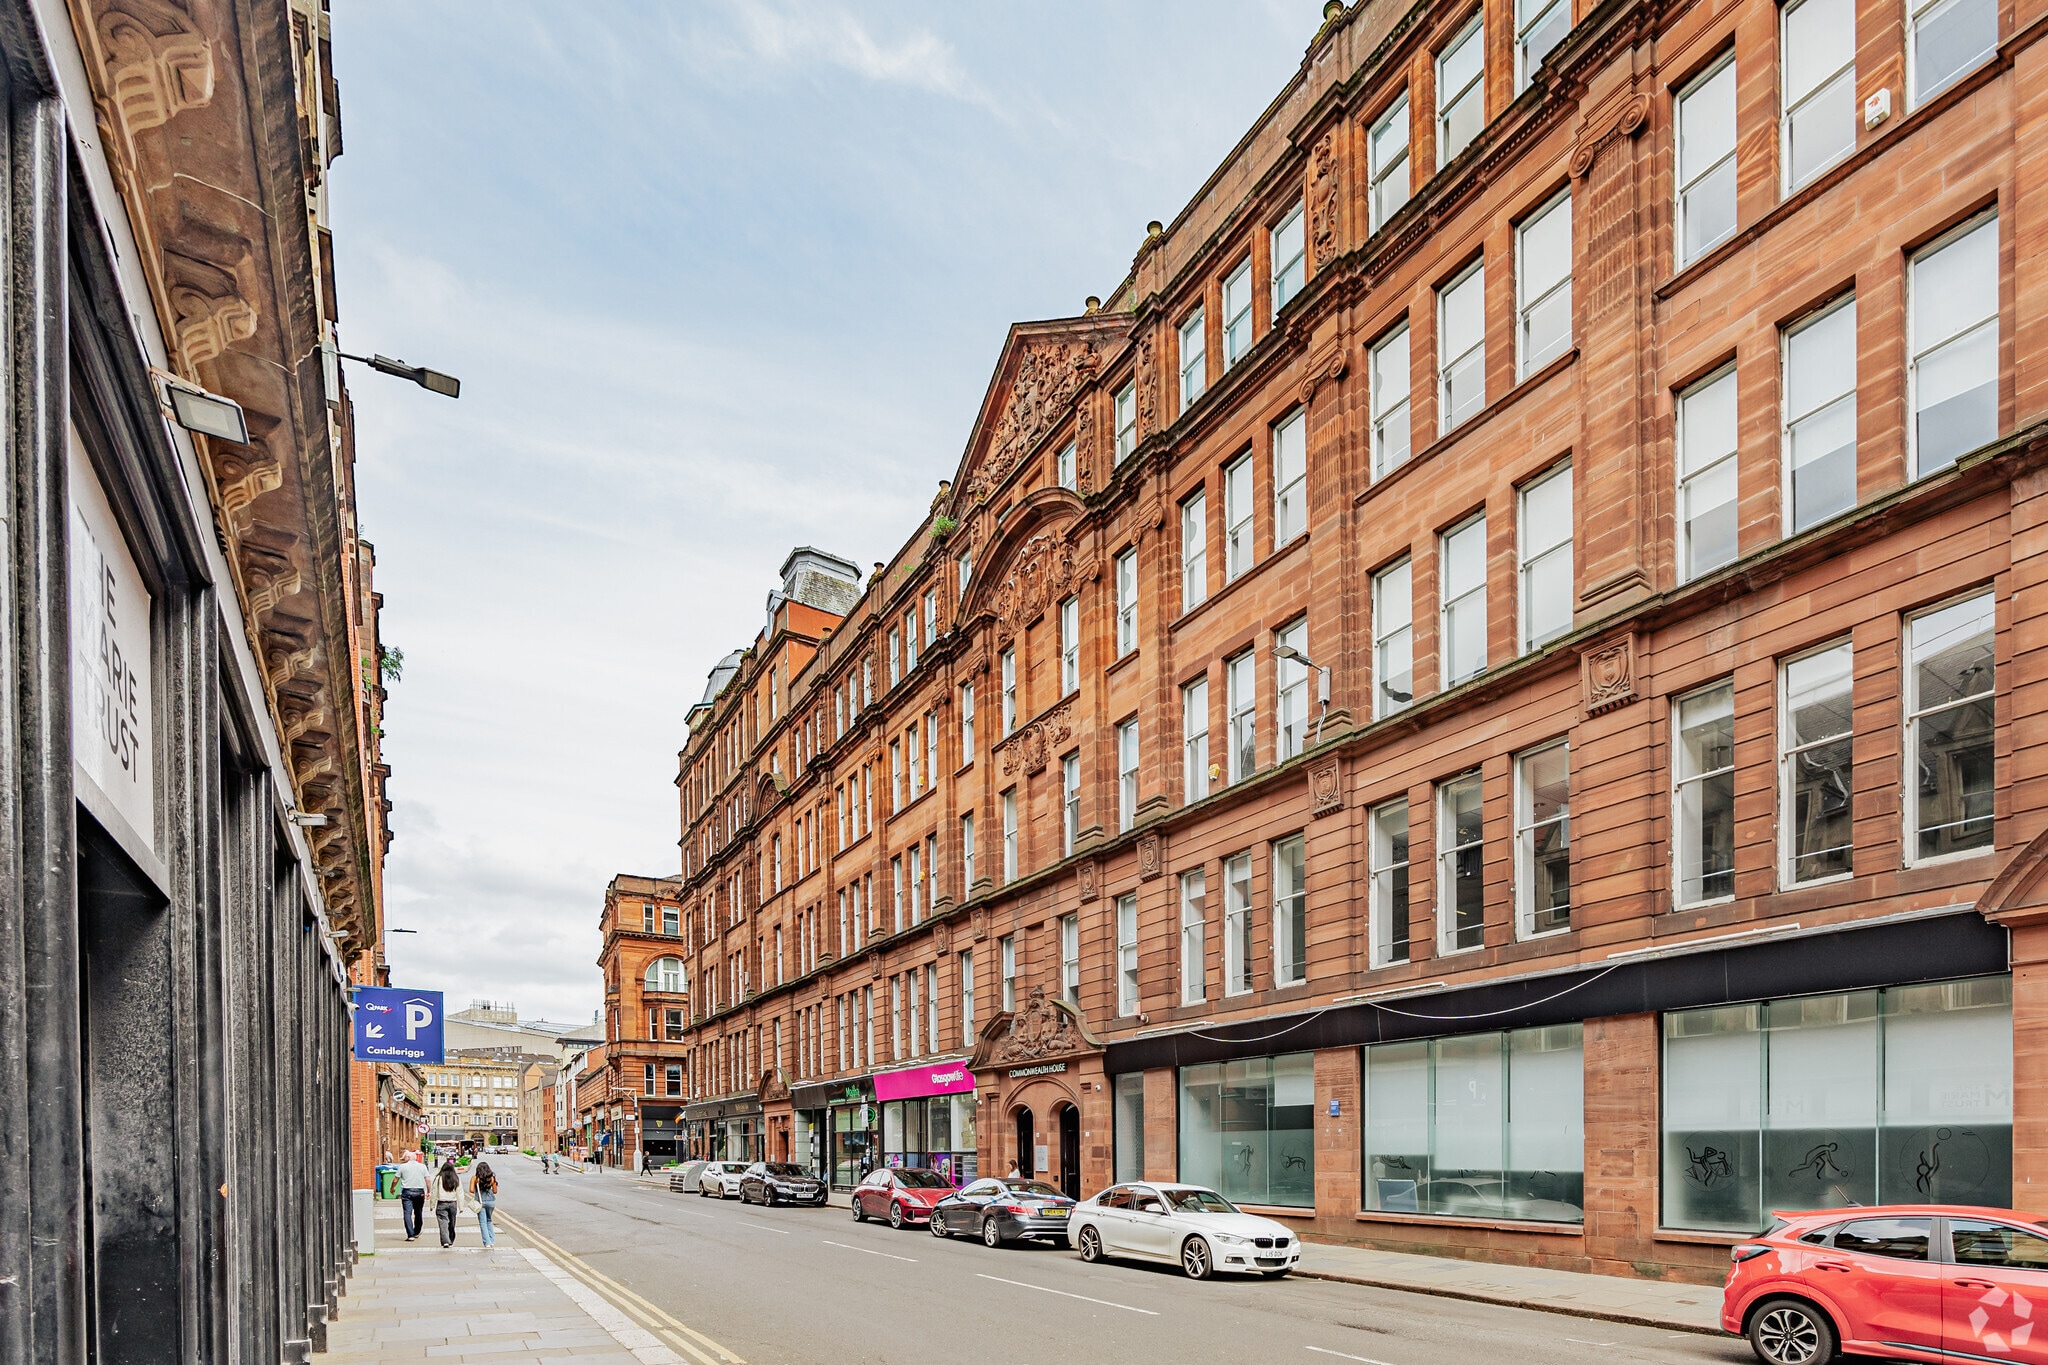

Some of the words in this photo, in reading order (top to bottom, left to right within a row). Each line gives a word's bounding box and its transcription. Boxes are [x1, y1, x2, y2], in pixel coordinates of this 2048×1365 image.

[79, 580, 138, 727] MARIE
[79, 649, 139, 784] TRUST
[406, 1004, 432, 1040] P
[366, 1046, 425, 1058] Candleriggs
[1009, 1065, 1049, 1078] COMMONWEALTH
[1049, 1063, 1065, 1072] HOUSE
